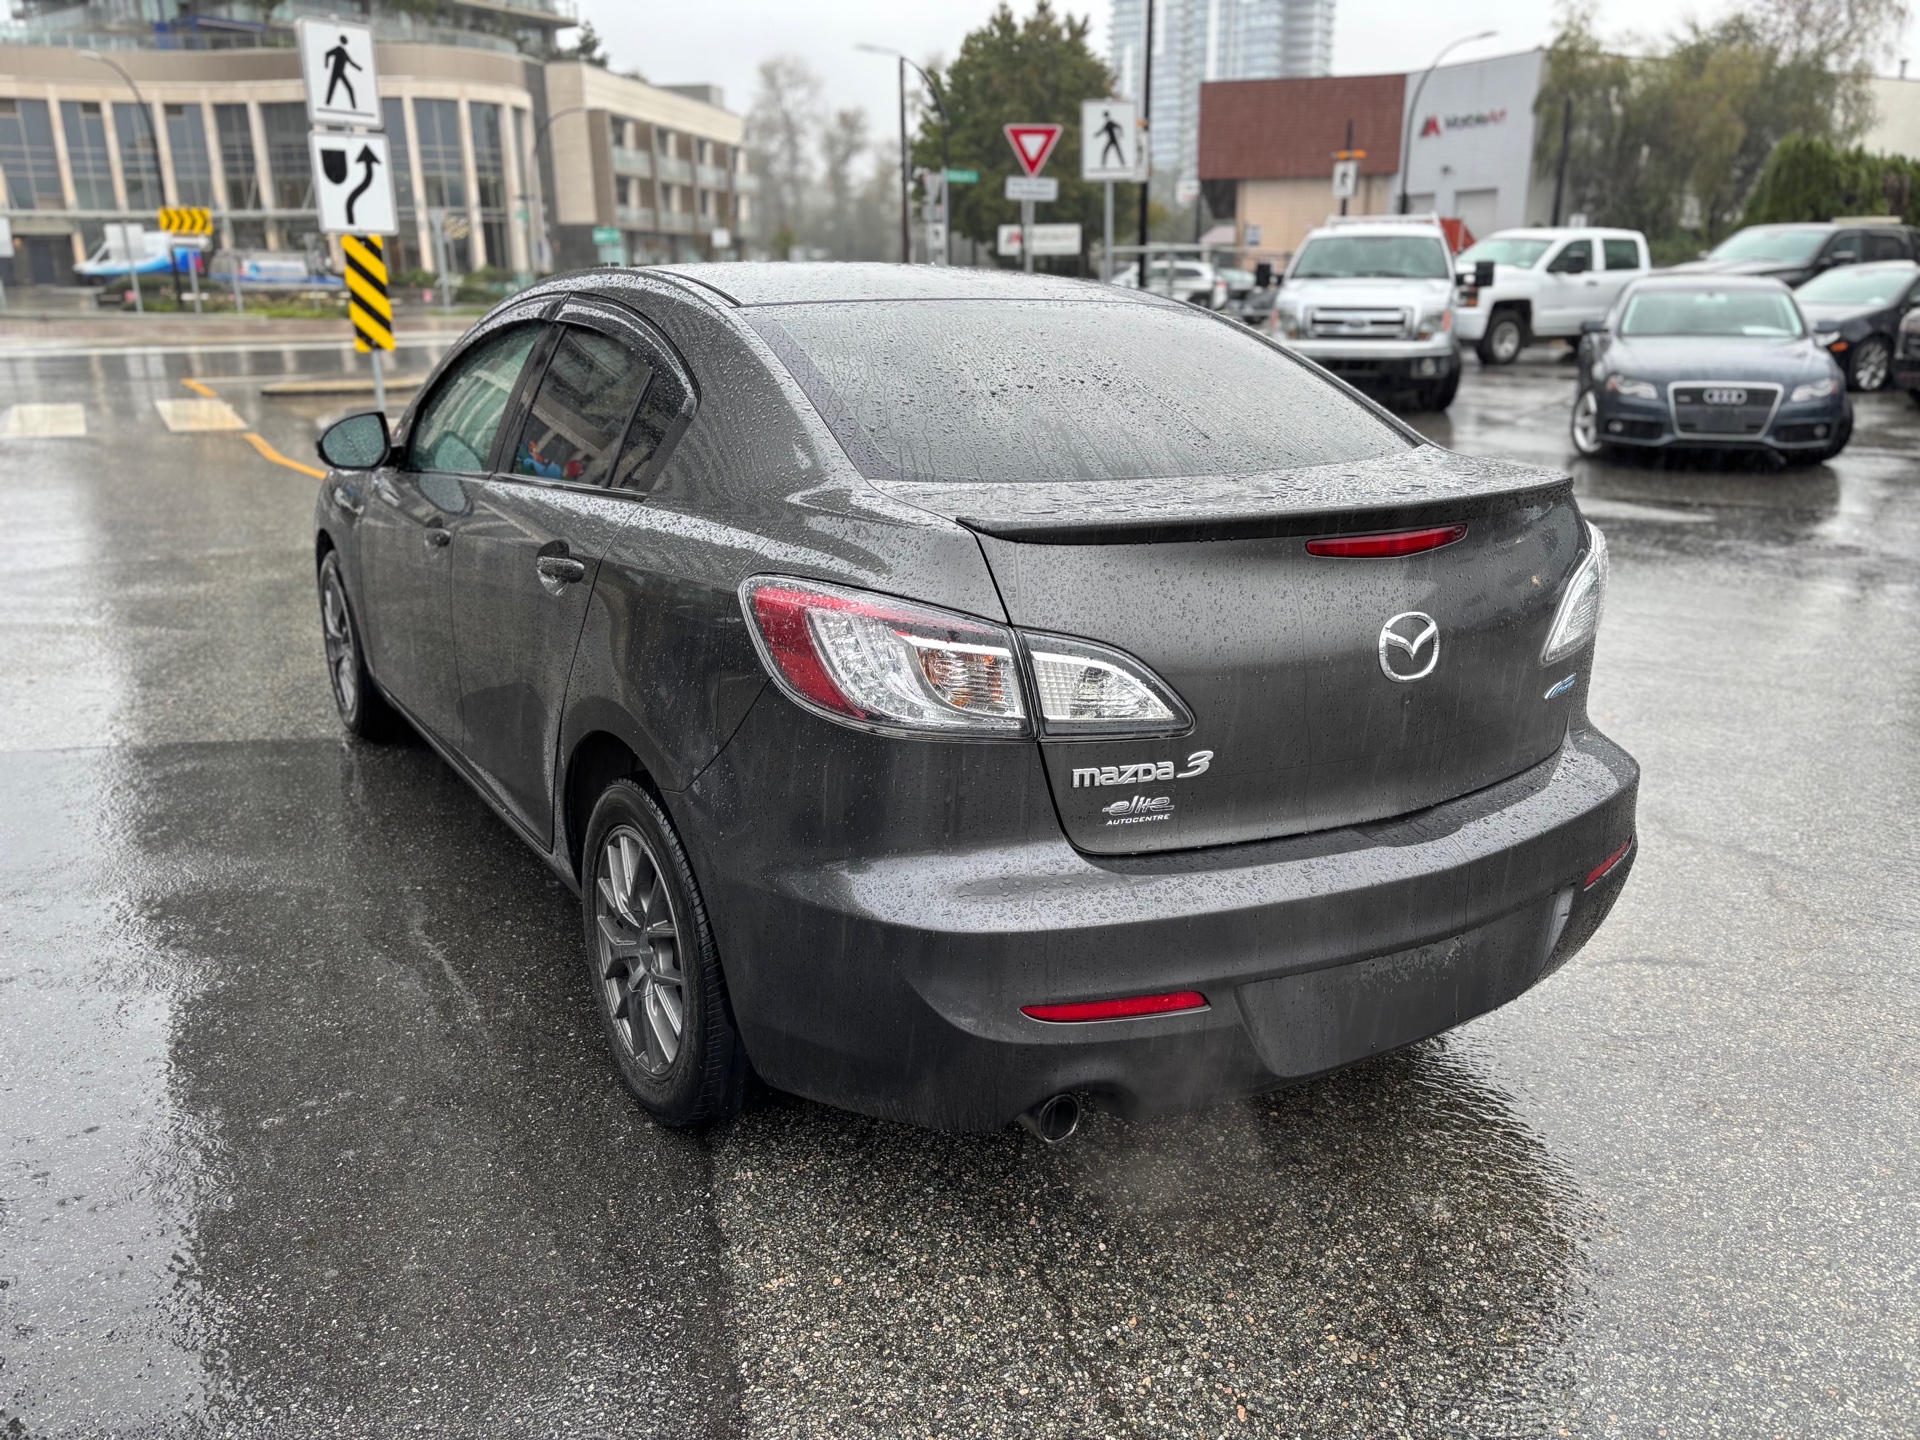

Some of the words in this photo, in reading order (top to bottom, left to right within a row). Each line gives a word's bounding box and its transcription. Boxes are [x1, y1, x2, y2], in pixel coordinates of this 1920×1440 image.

[1176, 750, 1214, 778] 3
[1102, 795, 1175, 816] elite
[1106, 813, 1170, 826] AUTOCENTRE
